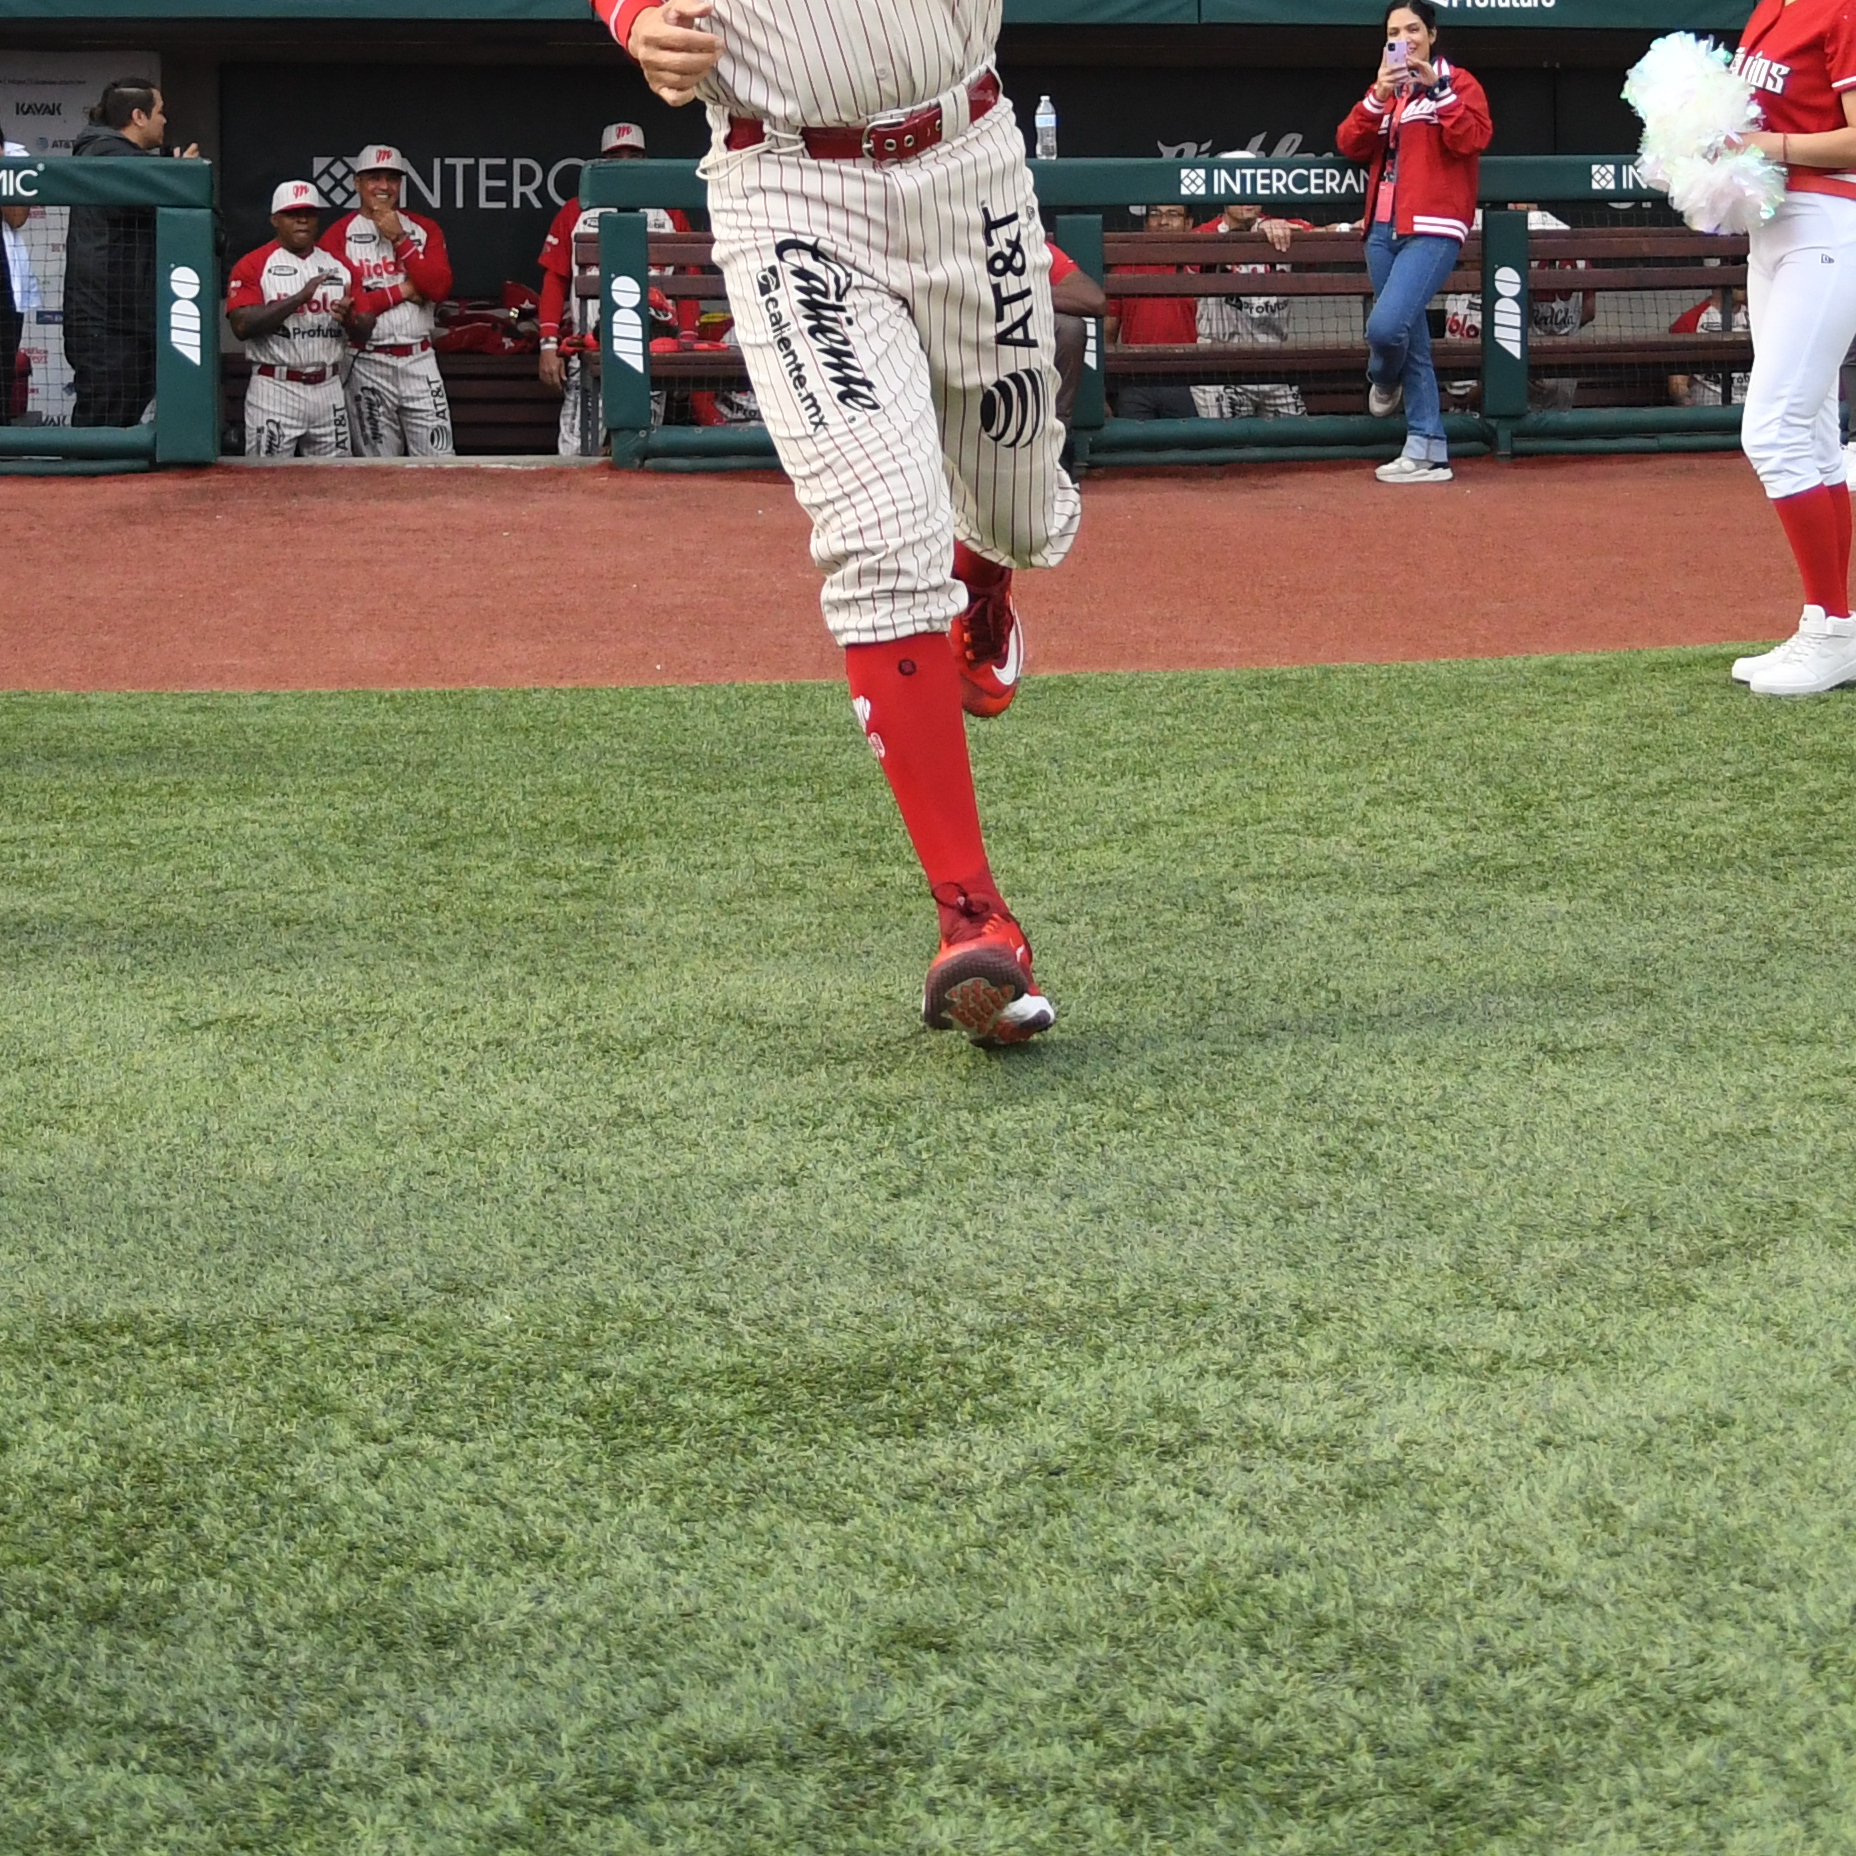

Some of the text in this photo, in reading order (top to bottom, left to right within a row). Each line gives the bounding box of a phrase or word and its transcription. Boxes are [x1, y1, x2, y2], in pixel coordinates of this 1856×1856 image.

[15, 102, 62, 117] KAVAK
[775, 237, 881, 413] Caliente
[981, 204, 1040, 348] AT&T
[764, 295, 830, 432] caliente.mx
